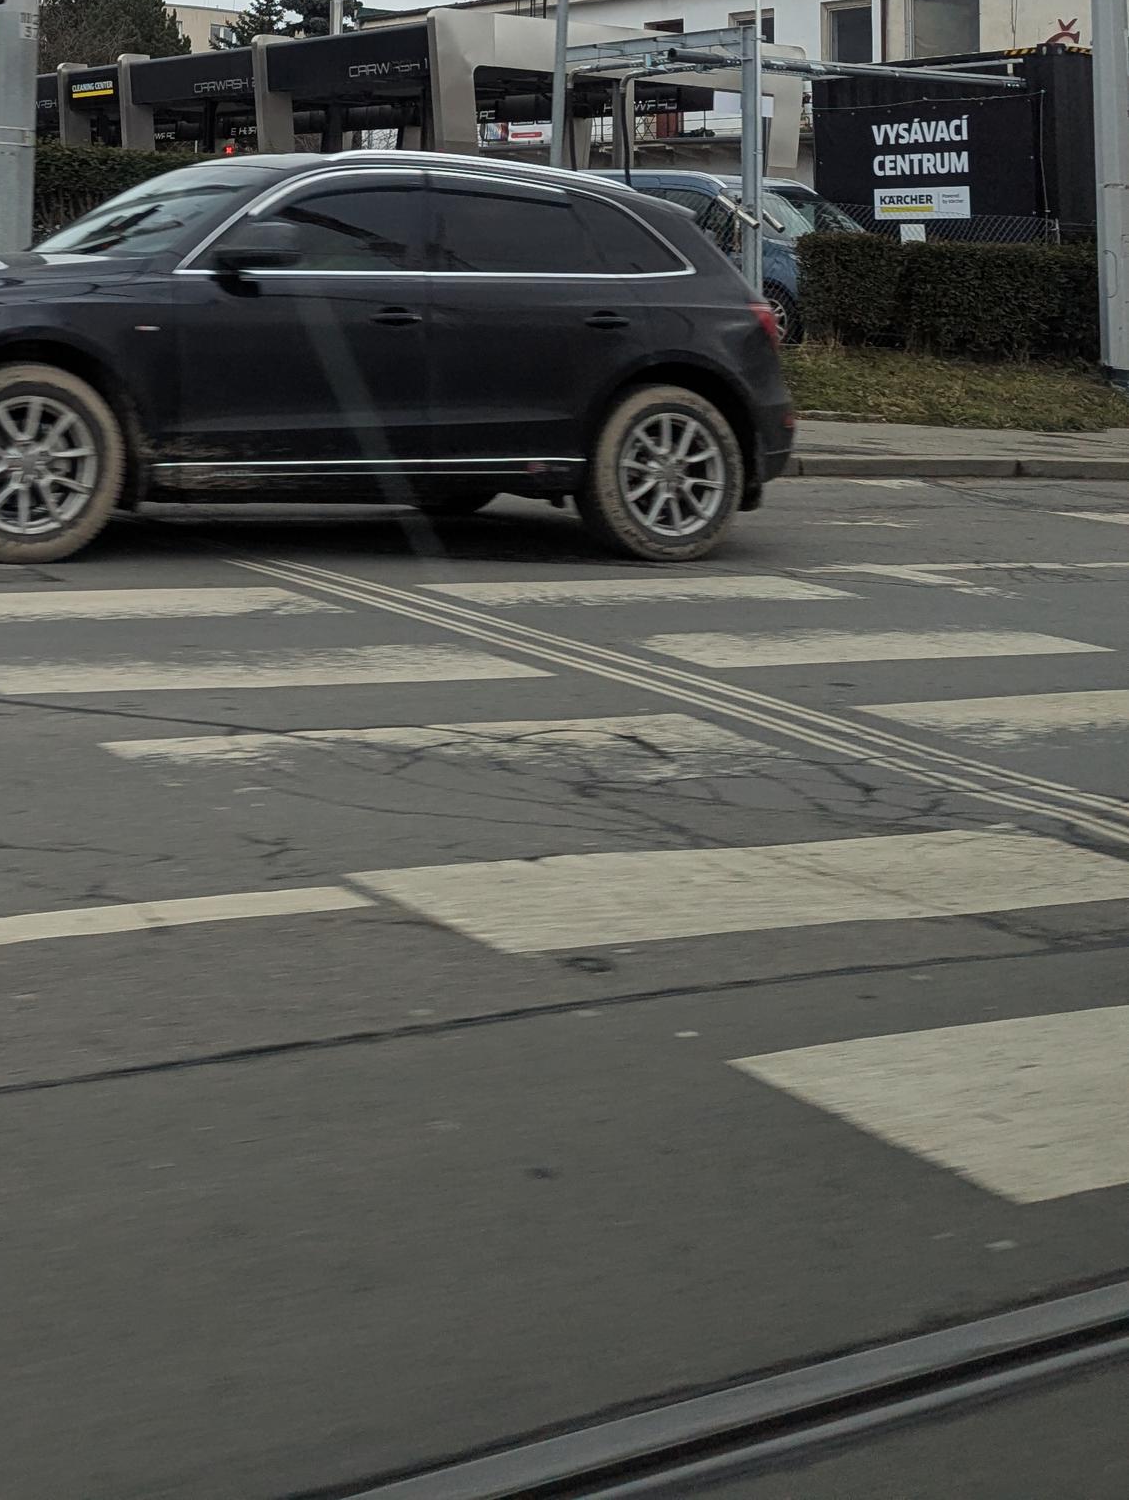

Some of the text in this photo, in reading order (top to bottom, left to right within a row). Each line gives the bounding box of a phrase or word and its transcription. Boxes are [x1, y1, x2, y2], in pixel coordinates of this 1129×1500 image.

[871, 115, 969, 146] VYSÁVACÍ
[873, 151, 969, 177] CENTRUM
[879, 194, 934, 206] KÄRCHER
